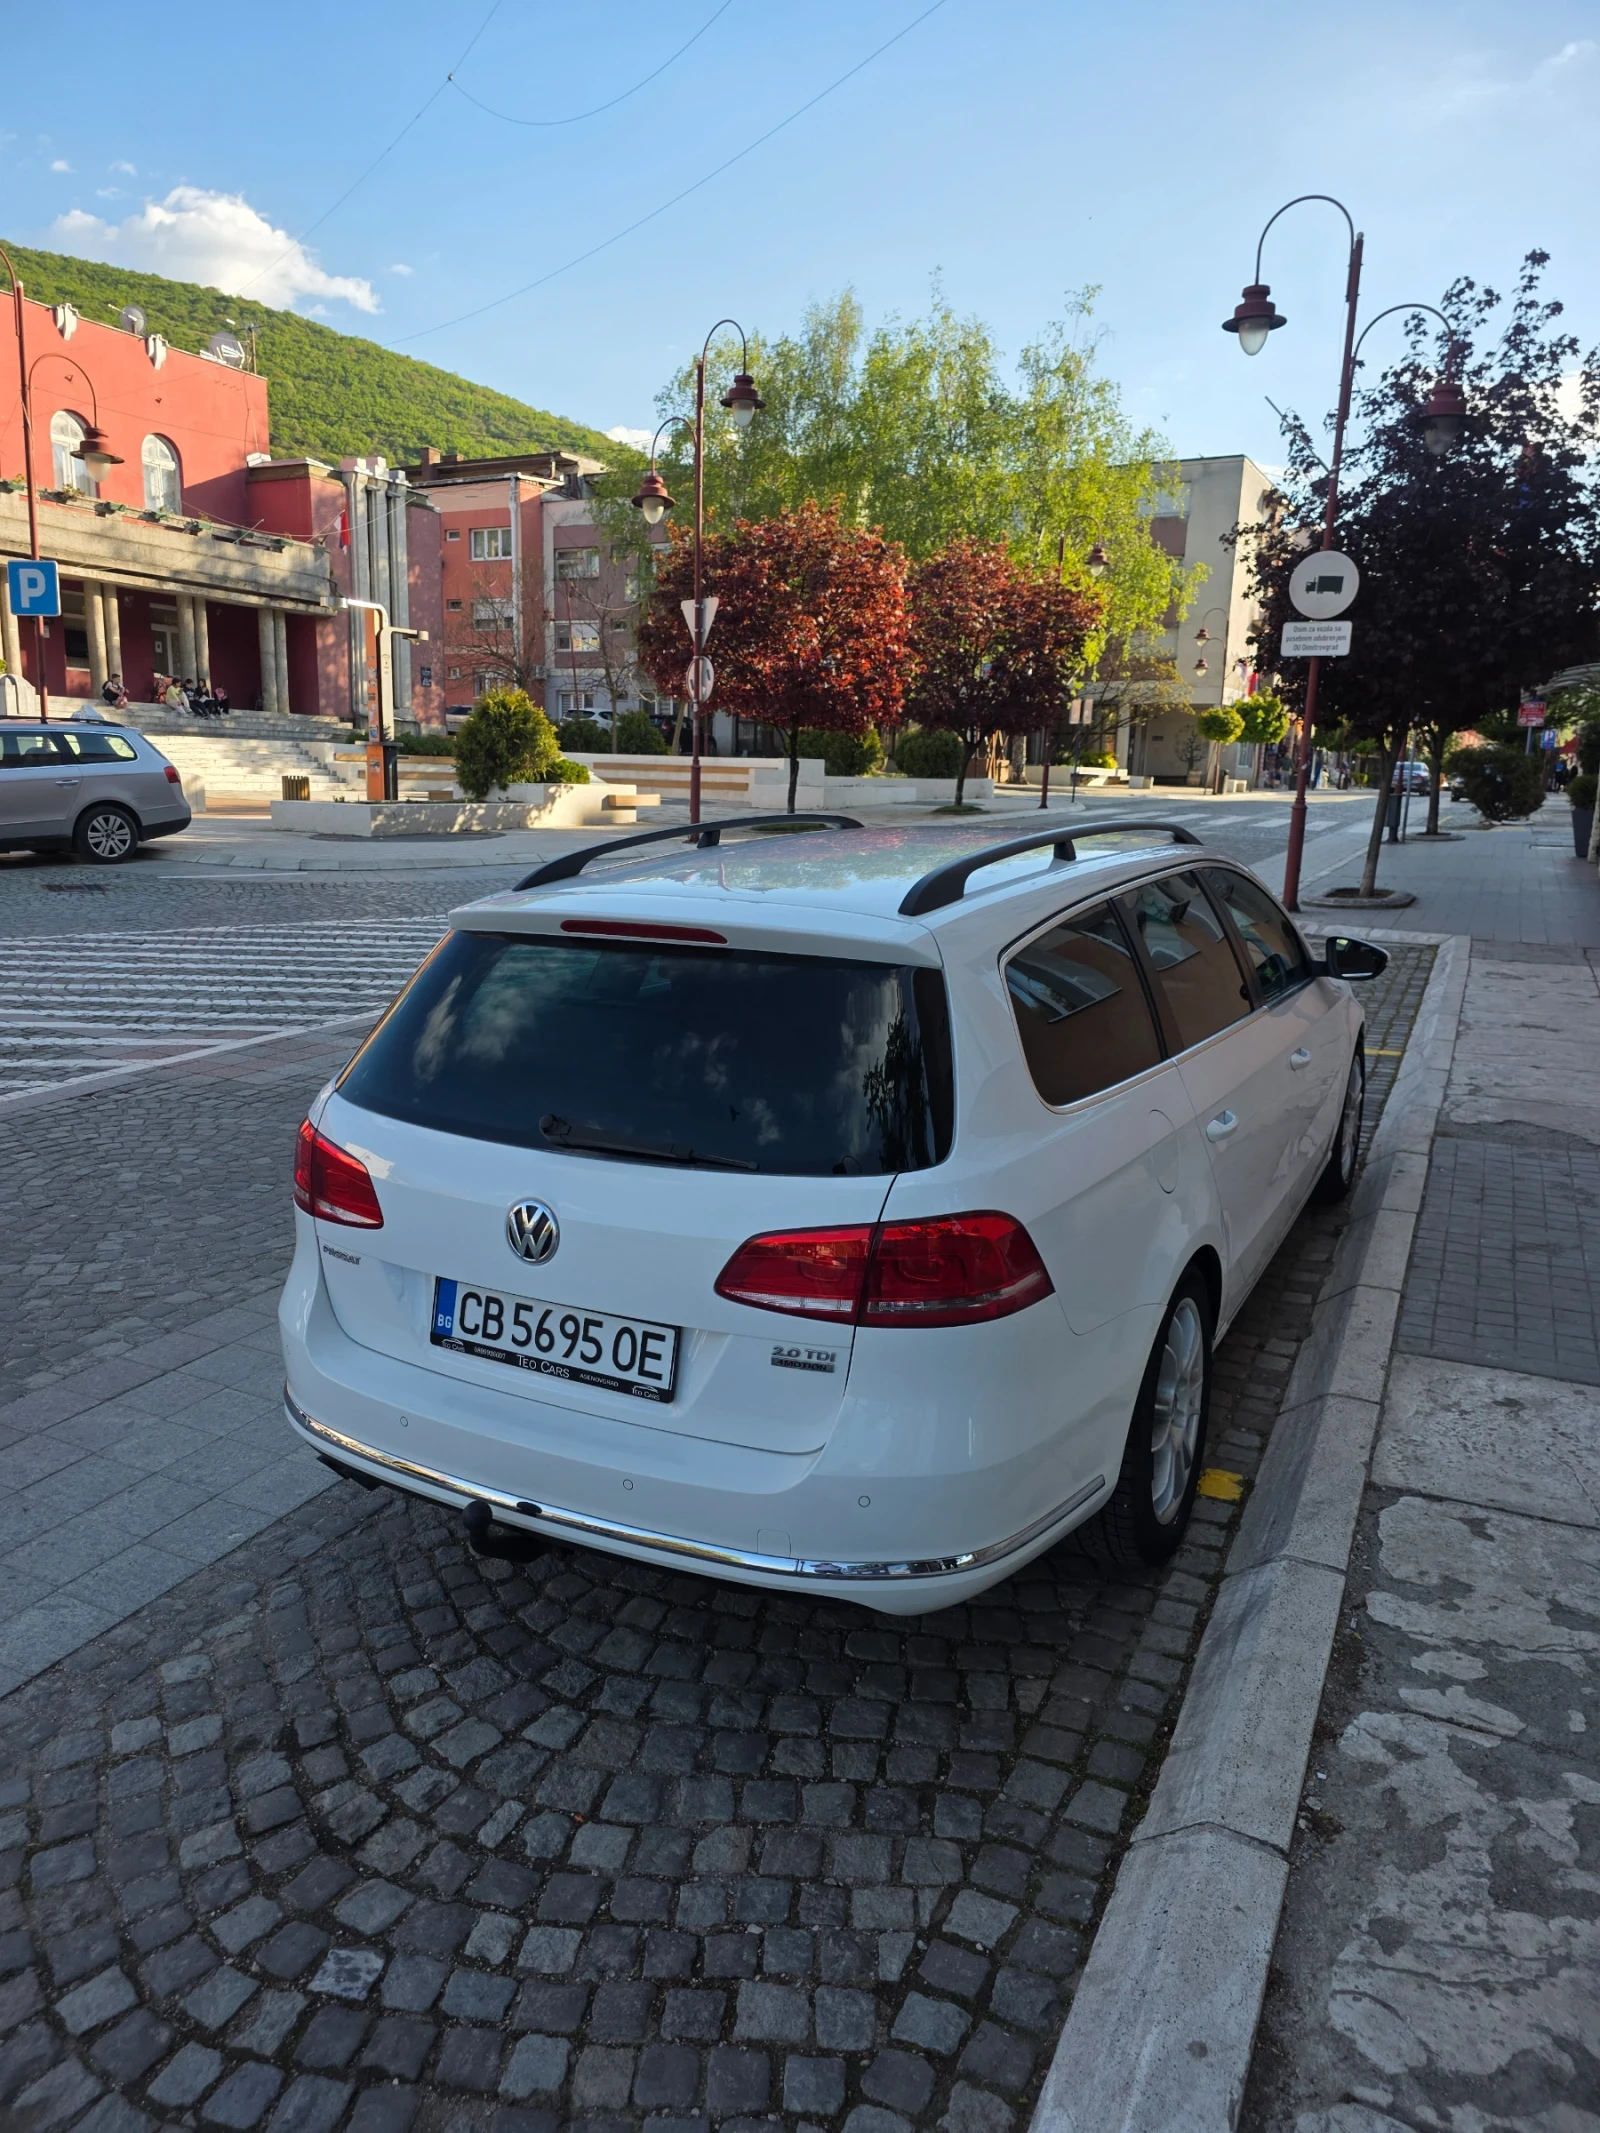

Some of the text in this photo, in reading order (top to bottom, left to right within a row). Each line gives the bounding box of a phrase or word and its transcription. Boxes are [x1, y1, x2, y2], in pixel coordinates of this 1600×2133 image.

[19, 568, 46, 609] P
[1285, 634, 1346, 643] posebnim odobrenjem
[1302, 644, 1339, 652] Dimitrovgrad
[1544, 730, 1553, 741] P
[437, 1313, 453, 1329] BG
[459, 1291, 504, 1341] CB
[511, 1302, 604, 1365] 5695
[804, 1347, 837, 1362] TDI
[579, 1373, 619, 1388] ASENOVGRAD
